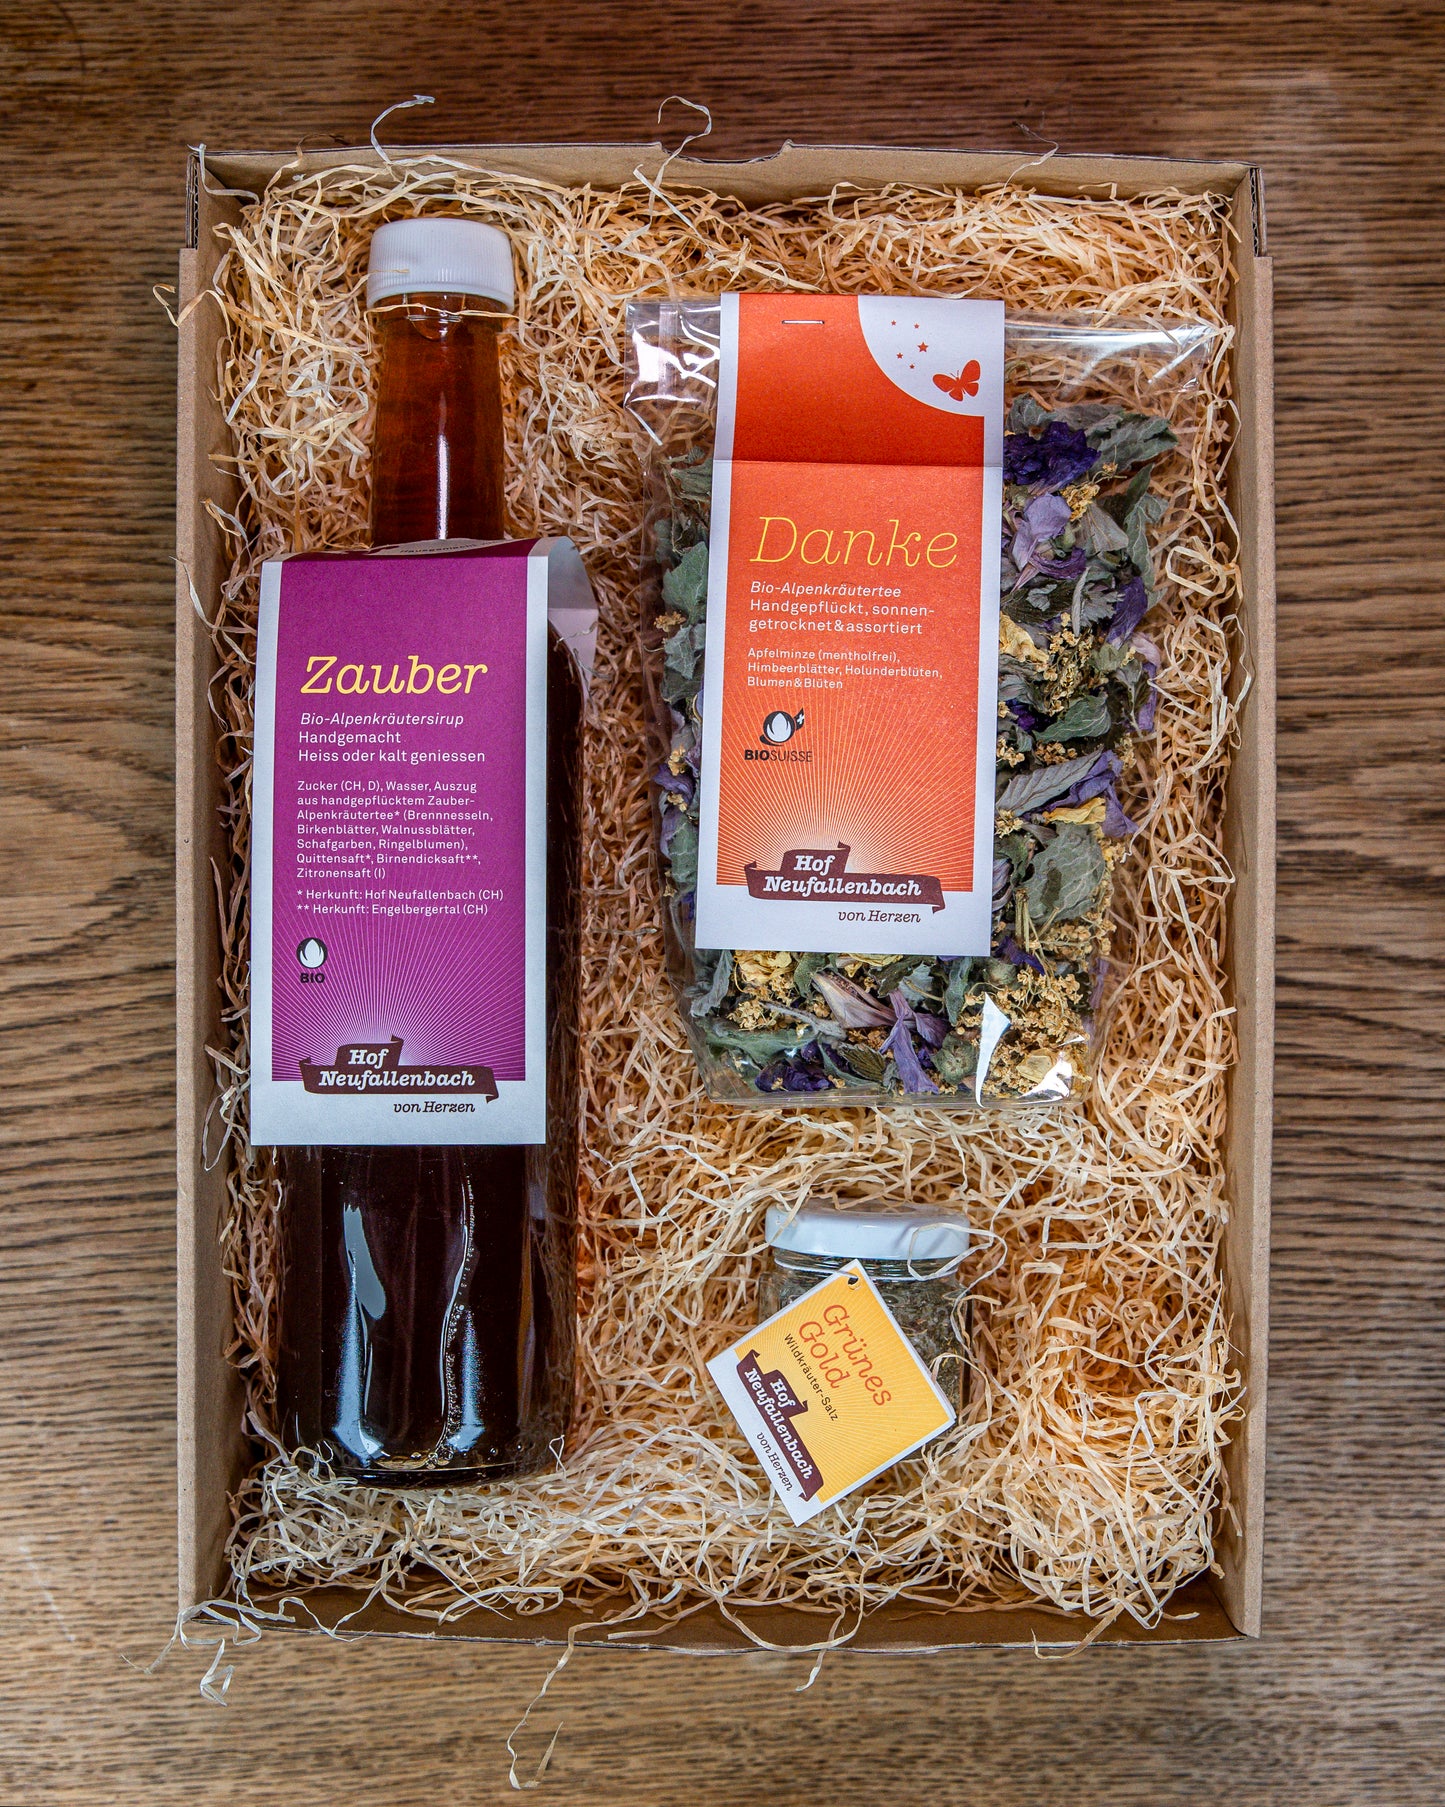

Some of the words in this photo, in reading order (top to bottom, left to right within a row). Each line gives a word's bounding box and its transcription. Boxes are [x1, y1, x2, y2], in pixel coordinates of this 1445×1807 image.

[749, 516, 958, 569] Danke
[750, 580, 902, 598] Bio-Alpenkräutertee
[750, 599, 870, 616] Handgepflückt,
[872, 604, 935, 617] sonnen-
[747, 647, 816, 660] Apfelminze
[818, 649, 900, 663] (mentholfrei),
[299, 654, 489, 695] Zauber
[747, 662, 843, 676] Himbeerblätter,
[844, 665, 943, 679] Holunderblüten,
[300, 711, 464, 728] Bio-Alpenkräutersirup
[298, 730, 402, 747] Handgemacht
[298, 749, 339, 763] Heiss
[341, 749, 376, 763] oder
[378, 749, 408, 763] kalt
[410, 749, 486, 765] geniessen
[297, 780, 338, 792] Zucker
[340, 780, 365, 793] (CH,
[368, 780, 384, 793] D),
[385, 780, 432, 793] Wasser,
[433, 780, 477, 794] Auszug
[297, 796, 319, 806] aus
[321, 795, 425, 808] handgepflücktem
[427, 795, 476, 806] Zauber-
[403, 809, 494, 822] (Brennnesseln,
[297, 824, 379, 836] Birkenblätter,
[381, 824, 476, 837] Walnussblätter,
[297, 839, 376, 852] Schafgarben,
[378, 839, 468, 852] Ringelblumen),
[296, 867, 372, 879] Zitronensaft
[793, 854, 836, 876] Hof
[306, 889, 363, 900] Herkunft:
[365, 889, 387, 900] Hof
[388, 889, 476, 900] Neufallenbach
[478, 889, 504, 901] (CH)
[763, 875, 922, 898] Neufallenbach
[313, 904, 370, 915] Herkunft:
[372, 904, 461, 917] Engelbergertal
[462, 904, 489, 916] (CH)
[838, 911, 866, 922] von
[868, 909, 922, 923] Herzen
[299, 972, 326, 984] BIO
[348, 1049, 390, 1069] Hof
[318, 1070, 476, 1092] Neufallenbach
[393, 1102, 421, 1113] von
[423, 1101, 476, 1113] Herzen
[798, 1320, 851, 1389] Gold
[821, 1303, 892, 1407] Grünes
[783, 1333, 839, 1422] Wildkräuter-Salz
[769, 1377, 796, 1409] Hof
[744, 1367, 813, 1480] Neufallenbach
[755, 1431, 772, 1453] von
[768, 1449, 794, 1492] Herzen
